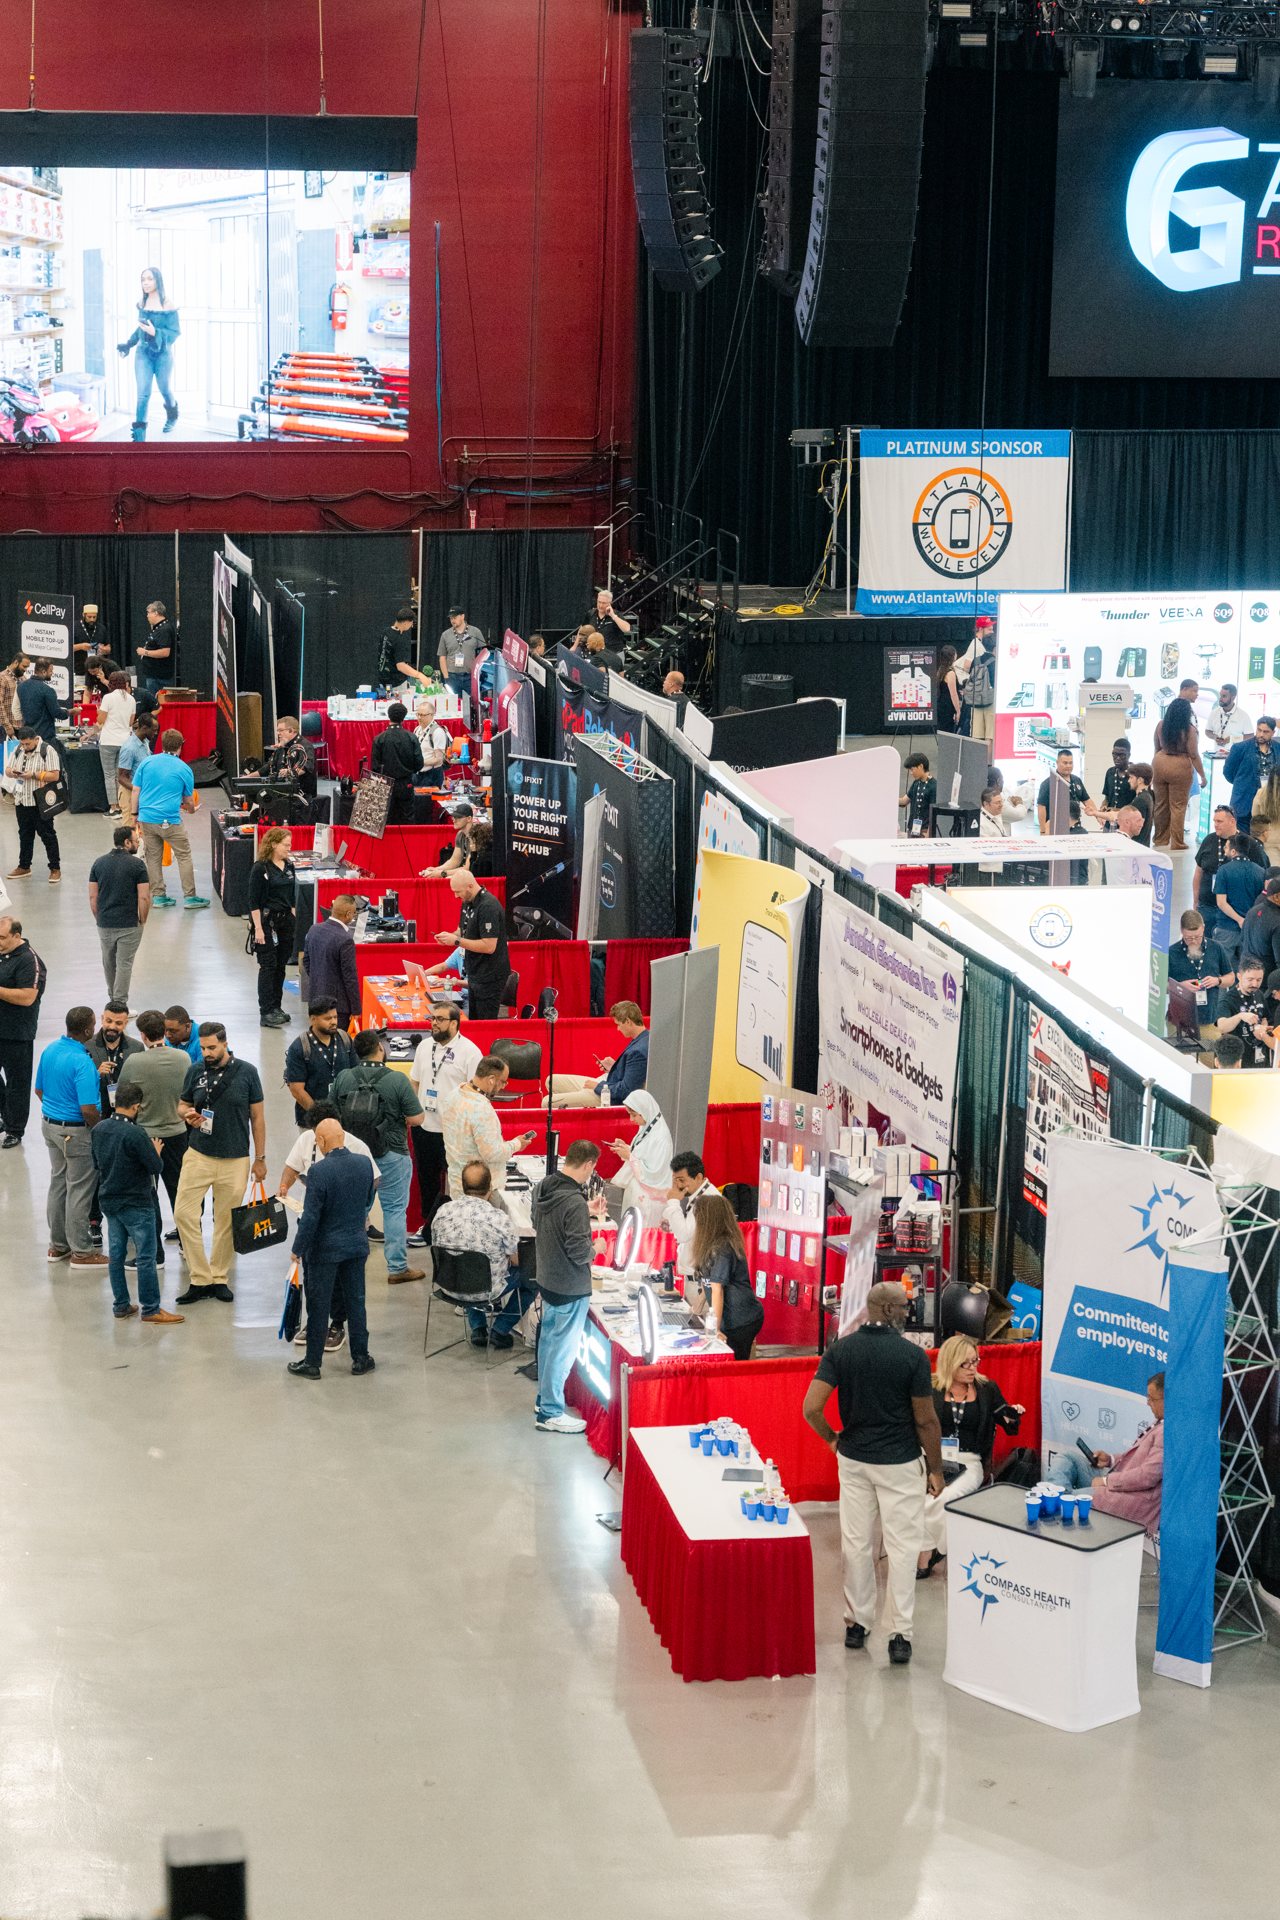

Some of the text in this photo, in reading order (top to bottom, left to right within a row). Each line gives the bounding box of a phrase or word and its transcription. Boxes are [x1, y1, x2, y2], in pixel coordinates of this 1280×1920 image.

[886, 441, 1043, 455] PLATINUM SPONSOR
[922, 476, 1005, 518] ATLANTA
[920, 527, 1005, 572] WHOLECELL
[34, 603, 66, 620] CellPay
[1100, 609, 1149, 621] Thunder
[1159, 607, 1204, 618] VEEXA
[1214, 608, 1233, 617] SQ9
[1250, 608, 1270, 617] PQ8
[25, 635, 65, 645] MOBILE TOP-UP
[35, 628, 56, 636] INSTANT
[1089, 693, 1123, 702] VEEXA
[888, 711, 933, 721] FLOOR MAP
[513, 794, 562, 810] POWER UP
[513, 806, 568, 825] YOUR RIGHT
[513, 820, 560, 837] TO REPAIR
[877, 937, 921, 986] Electronics
[840, 957, 860, 977] Wholesale
[898, 995, 915, 1013] Trusted
[915, 1005, 926, 1019] Tech
[925, 1012, 940, 1030] Partner
[857, 1000, 917, 1051] WHOLESALE DEALS ON
[840, 1006, 944, 1102] Smartphones & Gadgets
[826, 1039, 836, 1053] Best
[836, 1045, 847, 1060] Prices
[860, 1064, 880, 1087] Availability
[888, 1084, 904, 1102] Verified
[903, 1095, 918, 1113] Devices
[927, 1110, 938, 1123] New
[939, 1118, 948, 1130] and
[253, 1218, 277, 1240] ATL
[1073, 1301, 1157, 1337] Committed
[1076, 1325, 1155, 1359] employers
[984, 1573, 1071, 1609] COMPASS HEALTH
